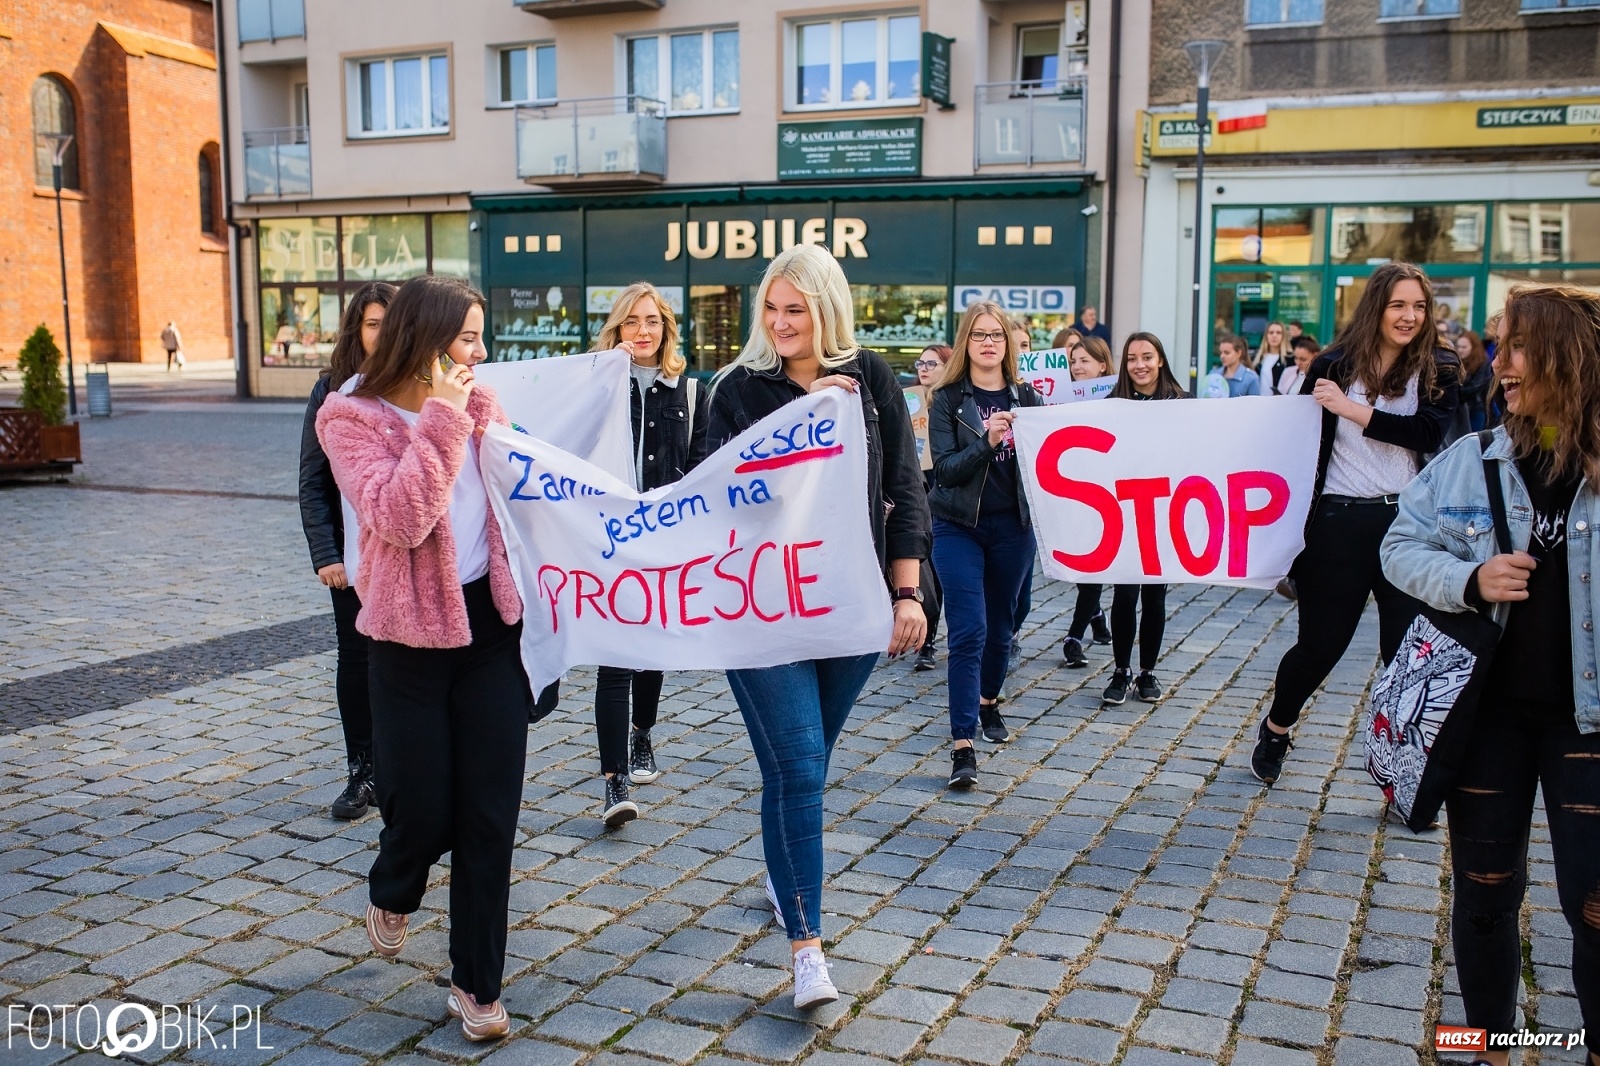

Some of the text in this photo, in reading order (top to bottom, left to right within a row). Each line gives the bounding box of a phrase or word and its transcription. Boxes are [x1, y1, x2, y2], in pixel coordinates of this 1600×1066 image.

[1482, 106, 1600, 126] STEFCZYK FIN
[801, 127, 917, 143] KANCELARIE ADWOKACKIE
[267, 227, 417, 271] STELLA
[960, 288, 1064, 310] CASIO
[1045, 352, 1068, 370] NA
[1030, 377, 1055, 397] EJ
[1035, 425, 1291, 578] STOP
[599, 478, 773, 560] jestem na
[537, 529, 834, 635] PROTEŚCIE
